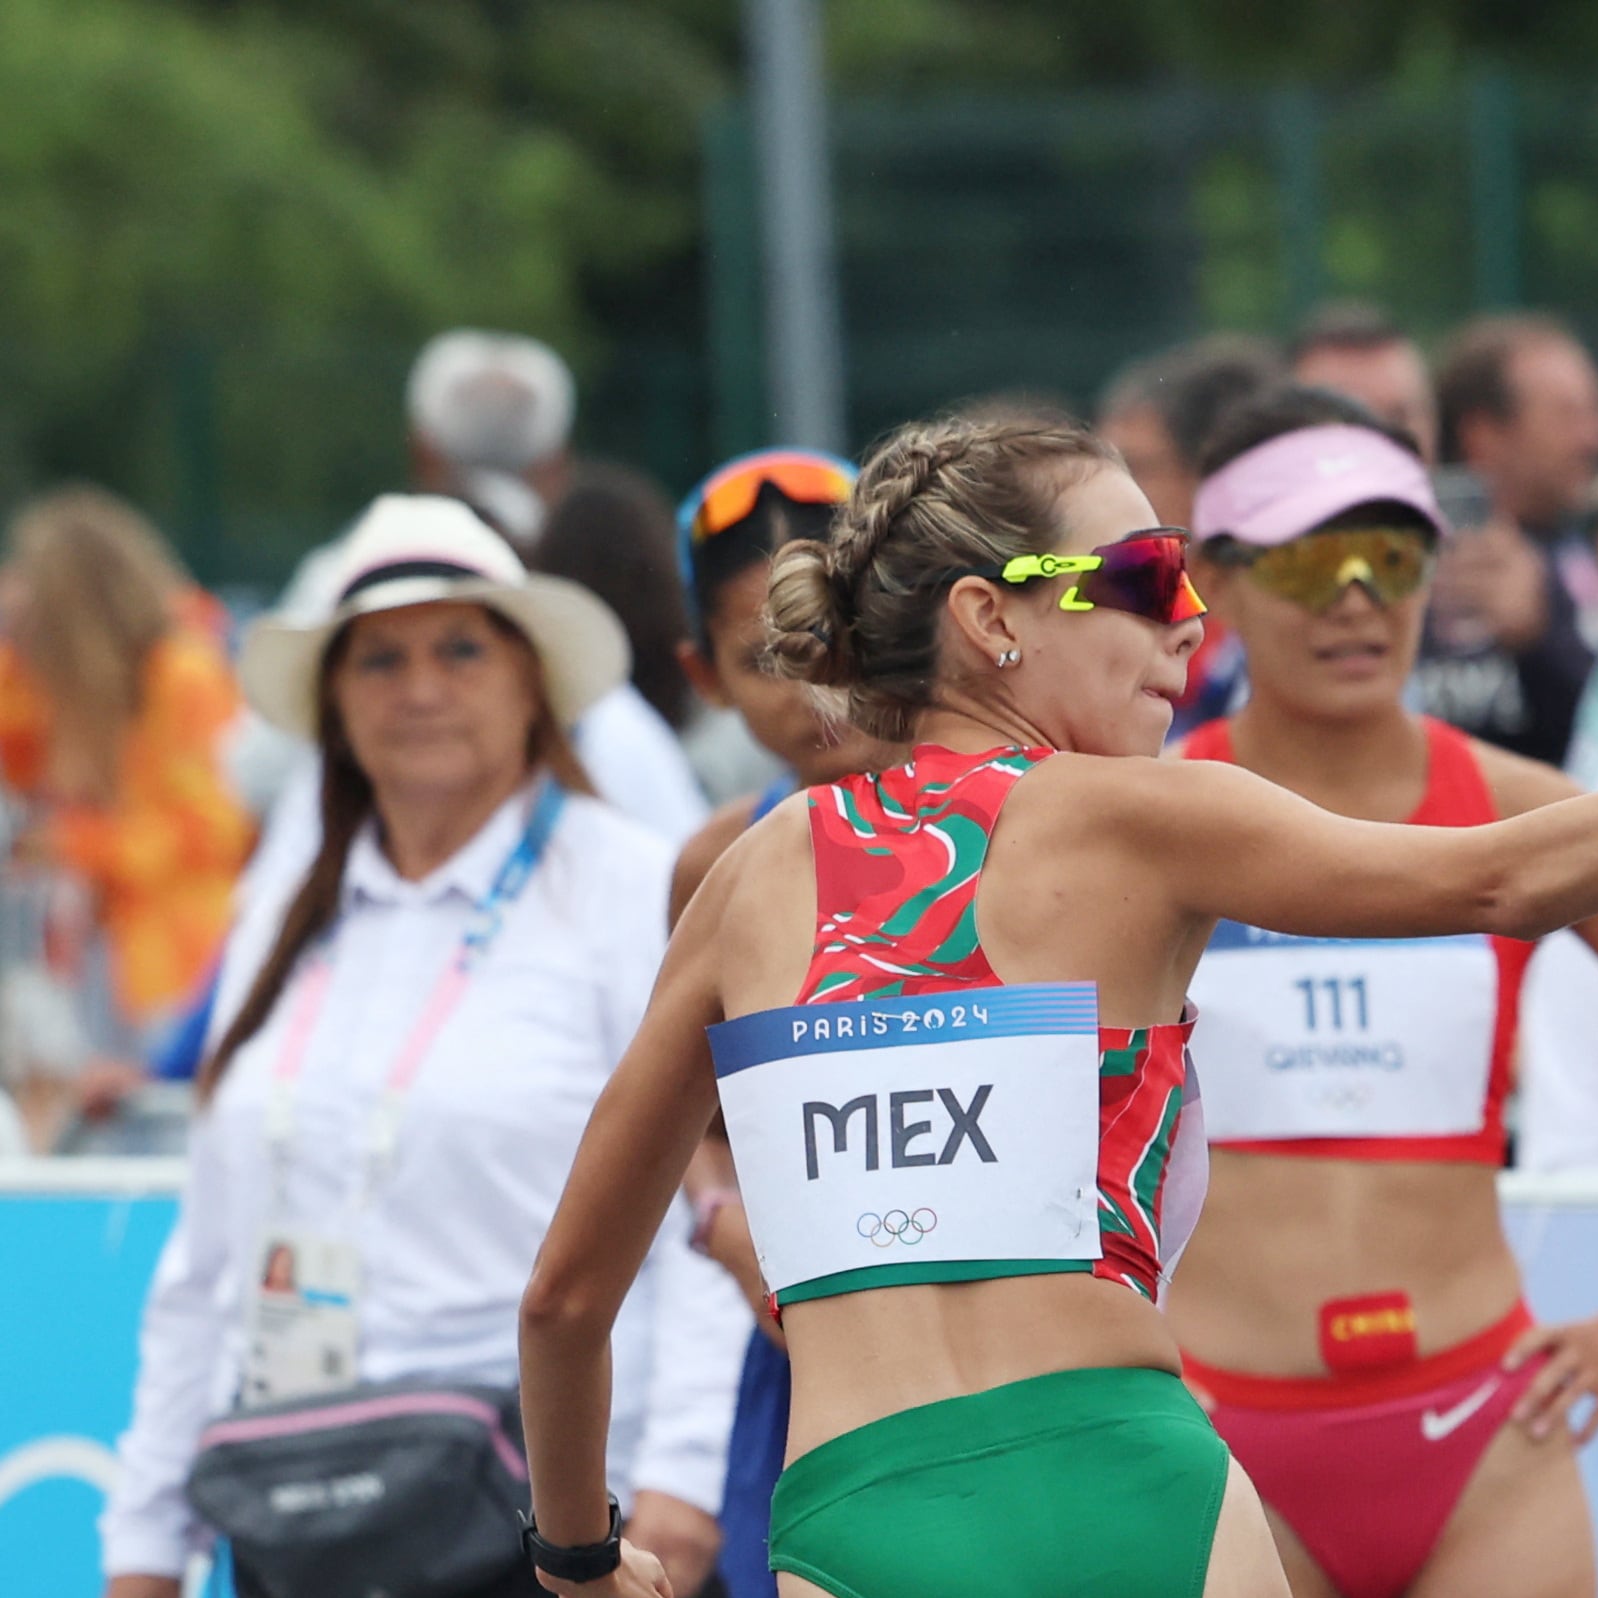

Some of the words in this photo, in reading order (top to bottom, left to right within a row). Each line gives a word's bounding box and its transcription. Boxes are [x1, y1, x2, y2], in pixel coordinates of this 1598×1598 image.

[902, 1004, 989, 1033] 2024
[1296, 975, 1367, 1030] 111
[803, 1084, 998, 1180] MEX
